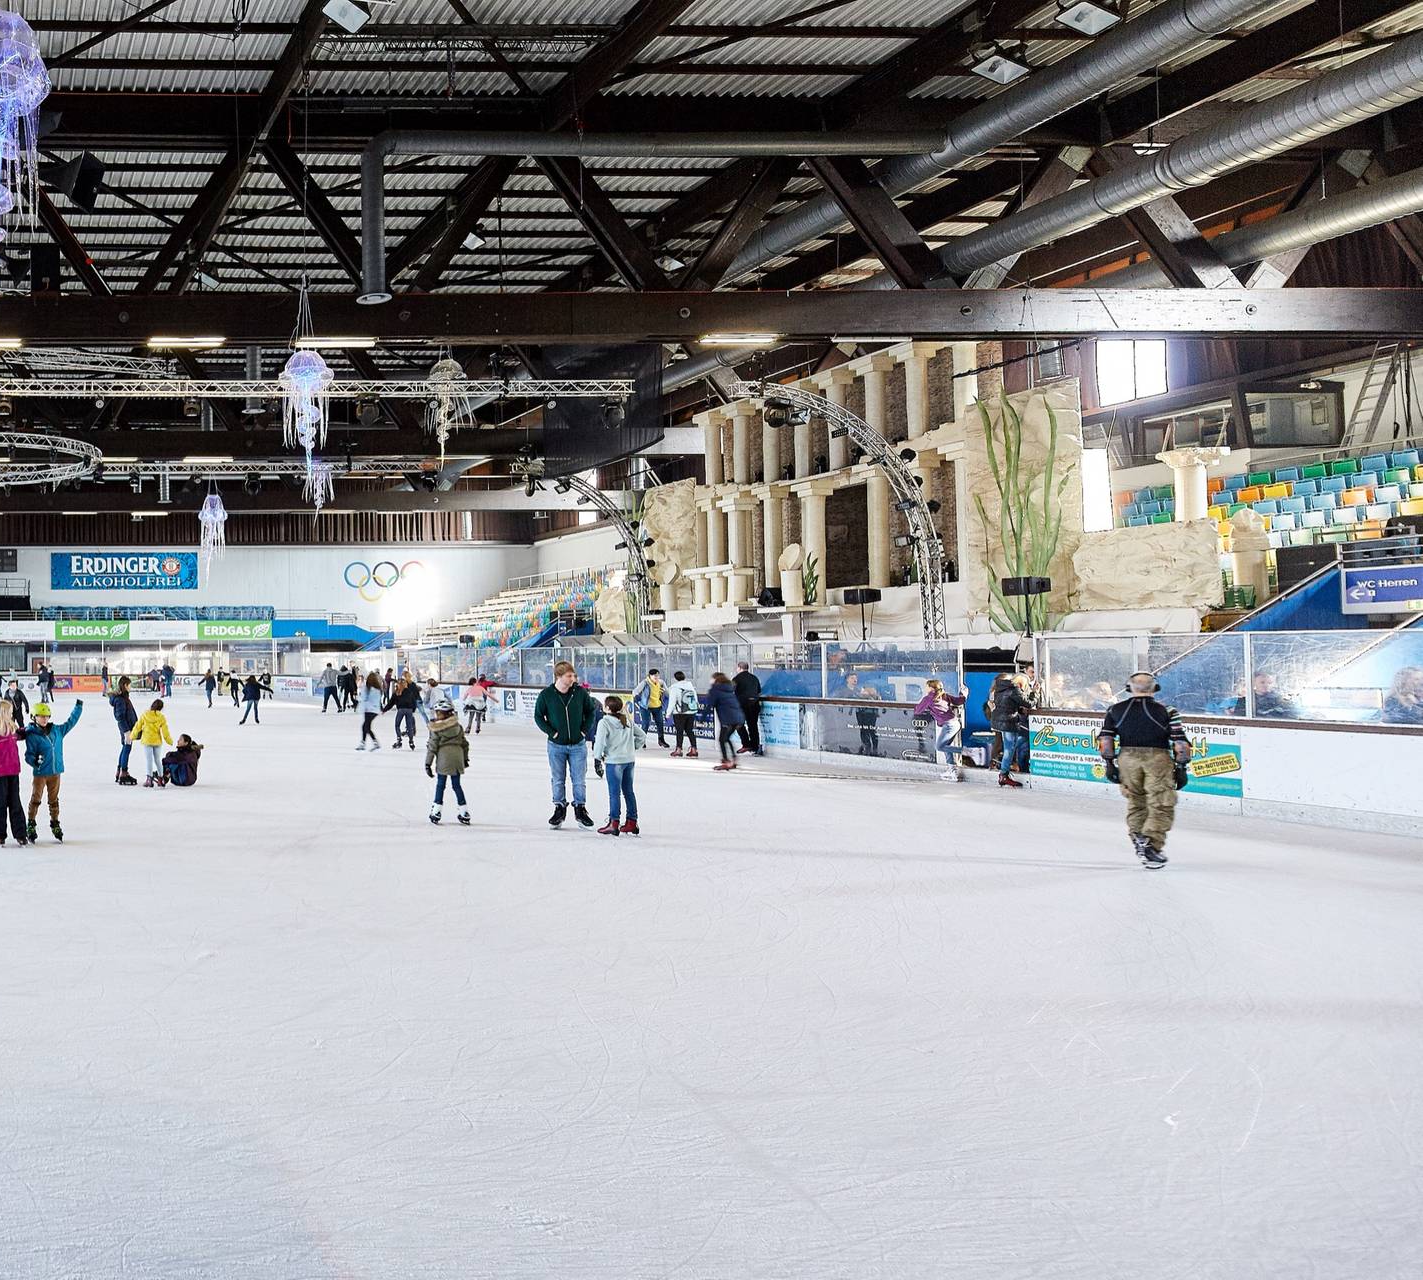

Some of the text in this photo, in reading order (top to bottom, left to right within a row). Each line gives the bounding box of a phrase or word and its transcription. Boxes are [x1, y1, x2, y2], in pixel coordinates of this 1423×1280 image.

[71, 555, 161, 575] ERDINGER
[72, 576, 180, 587] ALKOHOLFREI
[1357, 578, 1418, 588] WC Herren
[61, 625, 108, 636] ERDGAS
[203, 625, 251, 636] ERDGAS
[1033, 725, 1100, 751] Burch
